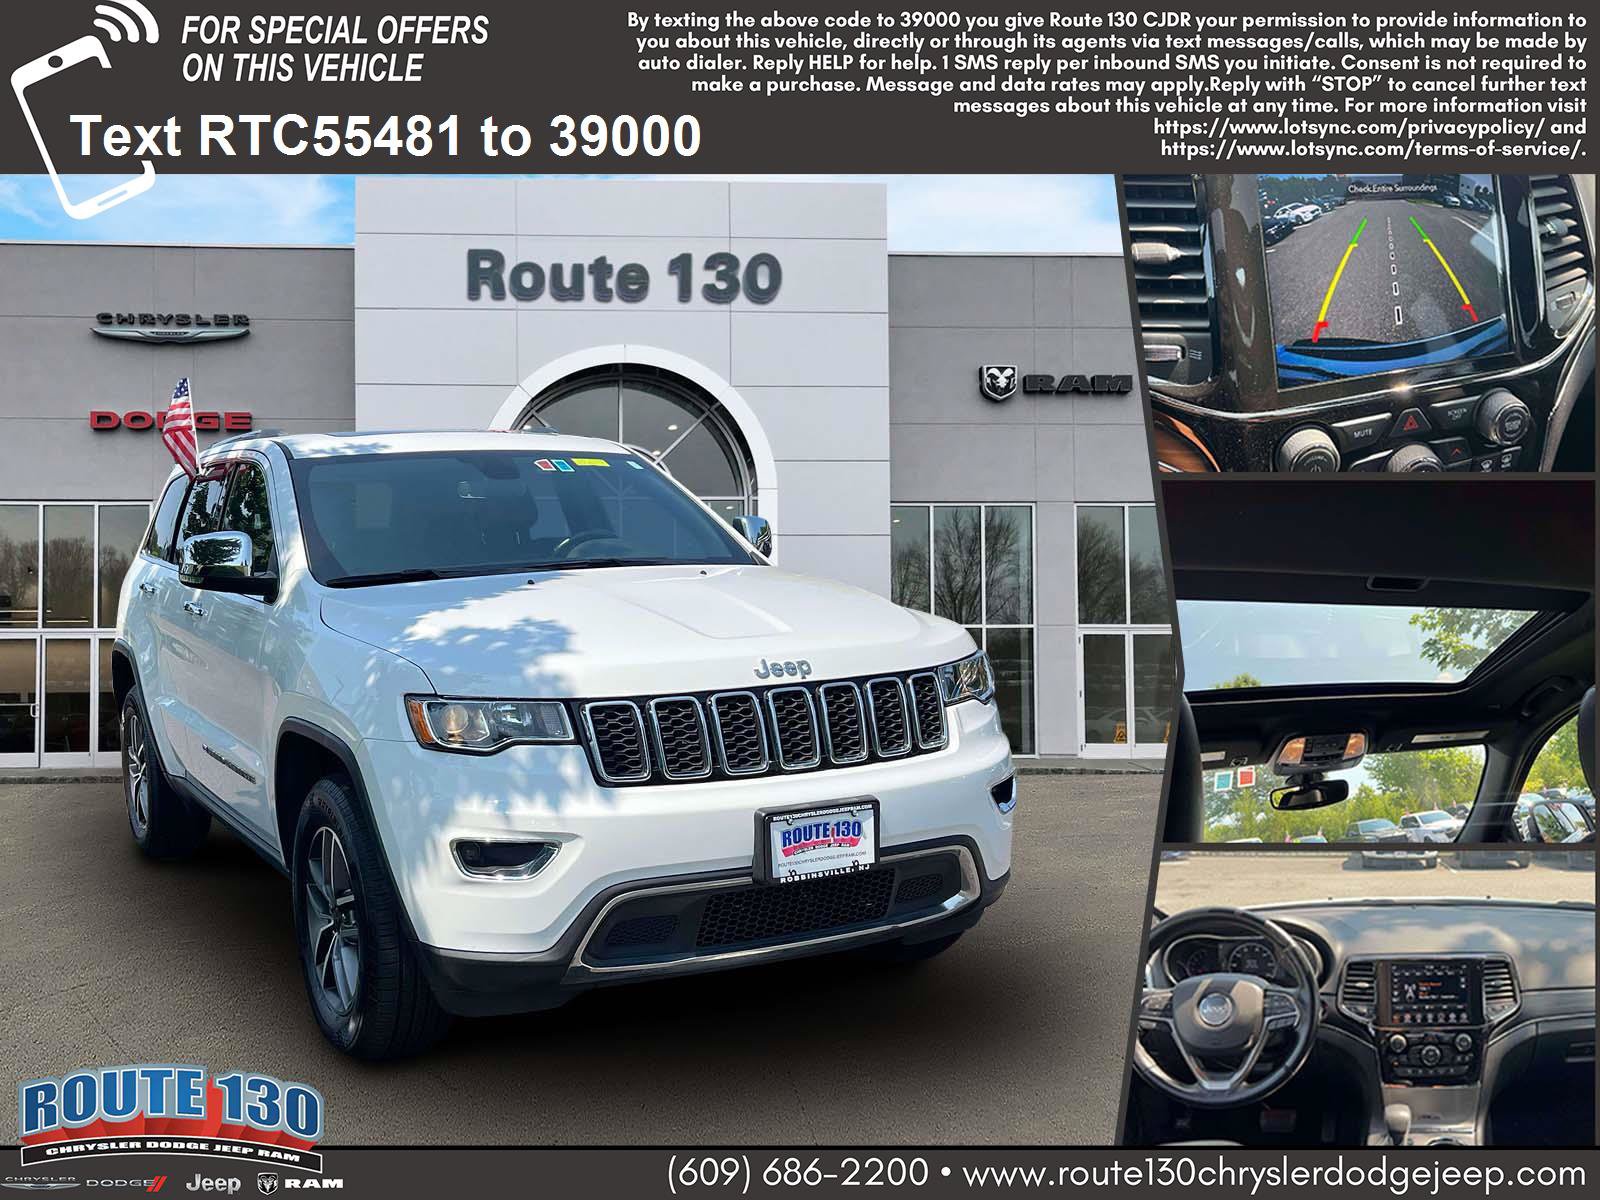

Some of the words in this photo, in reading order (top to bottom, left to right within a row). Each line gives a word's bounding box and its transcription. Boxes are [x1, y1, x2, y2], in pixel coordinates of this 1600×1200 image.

[1348, 184, 1372, 193] Check
[466, 249, 650, 303] Route
[667, 252, 783, 305] 130
[96, 312, 250, 326] CHRYSLER
[1023, 374, 1133, 393] RAM
[1353, 428, 1373, 439] MUTE
[754, 658, 812, 680] Jeep
[782, 822, 830, 848] ROUTE
[833, 820, 862, 837] 130
